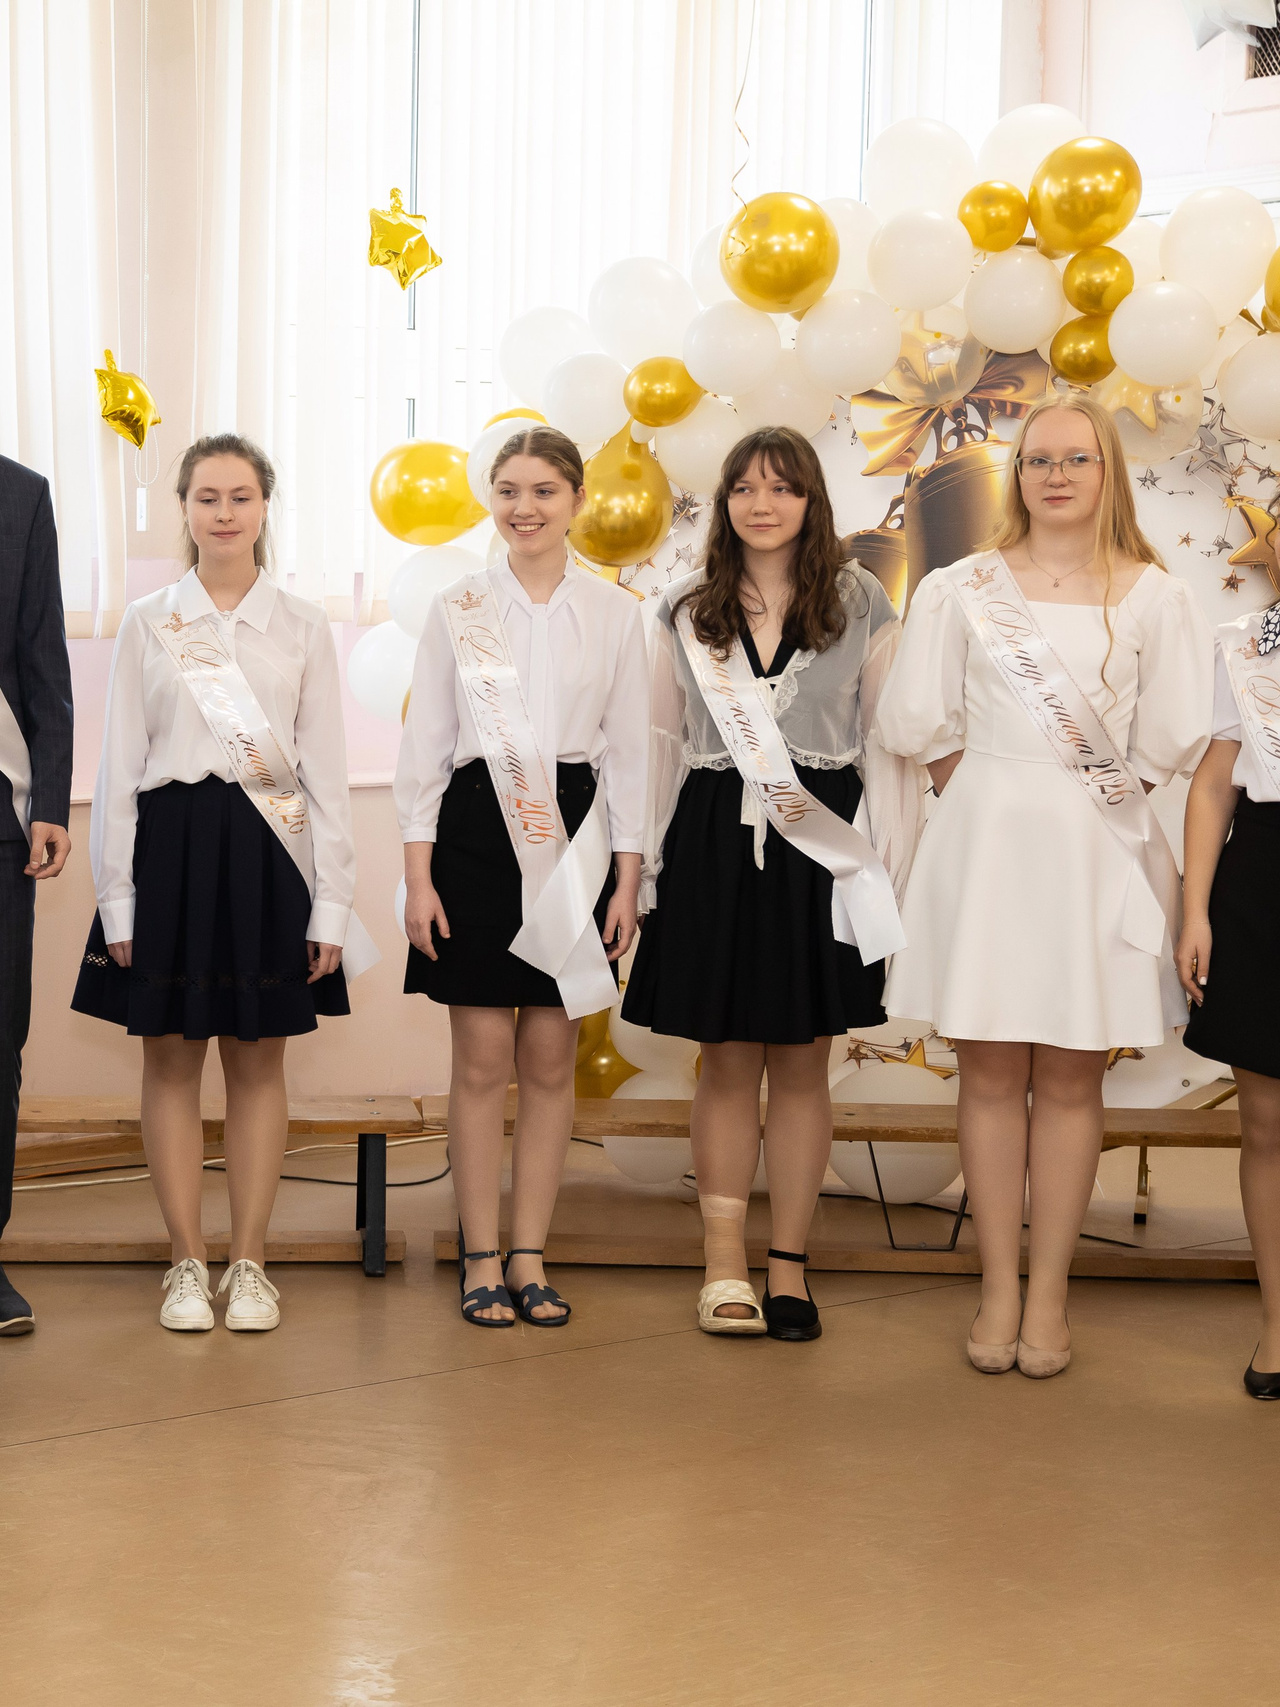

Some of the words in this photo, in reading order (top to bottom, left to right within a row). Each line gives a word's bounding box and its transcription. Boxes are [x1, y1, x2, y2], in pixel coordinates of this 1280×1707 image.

[982, 601, 1096, 759] Выпускница
[1081, 758, 1135, 806] 2026
[266, 790, 310, 835] 2026
[513, 797, 560, 845] 2026
[760, 781, 818, 823] 2026
